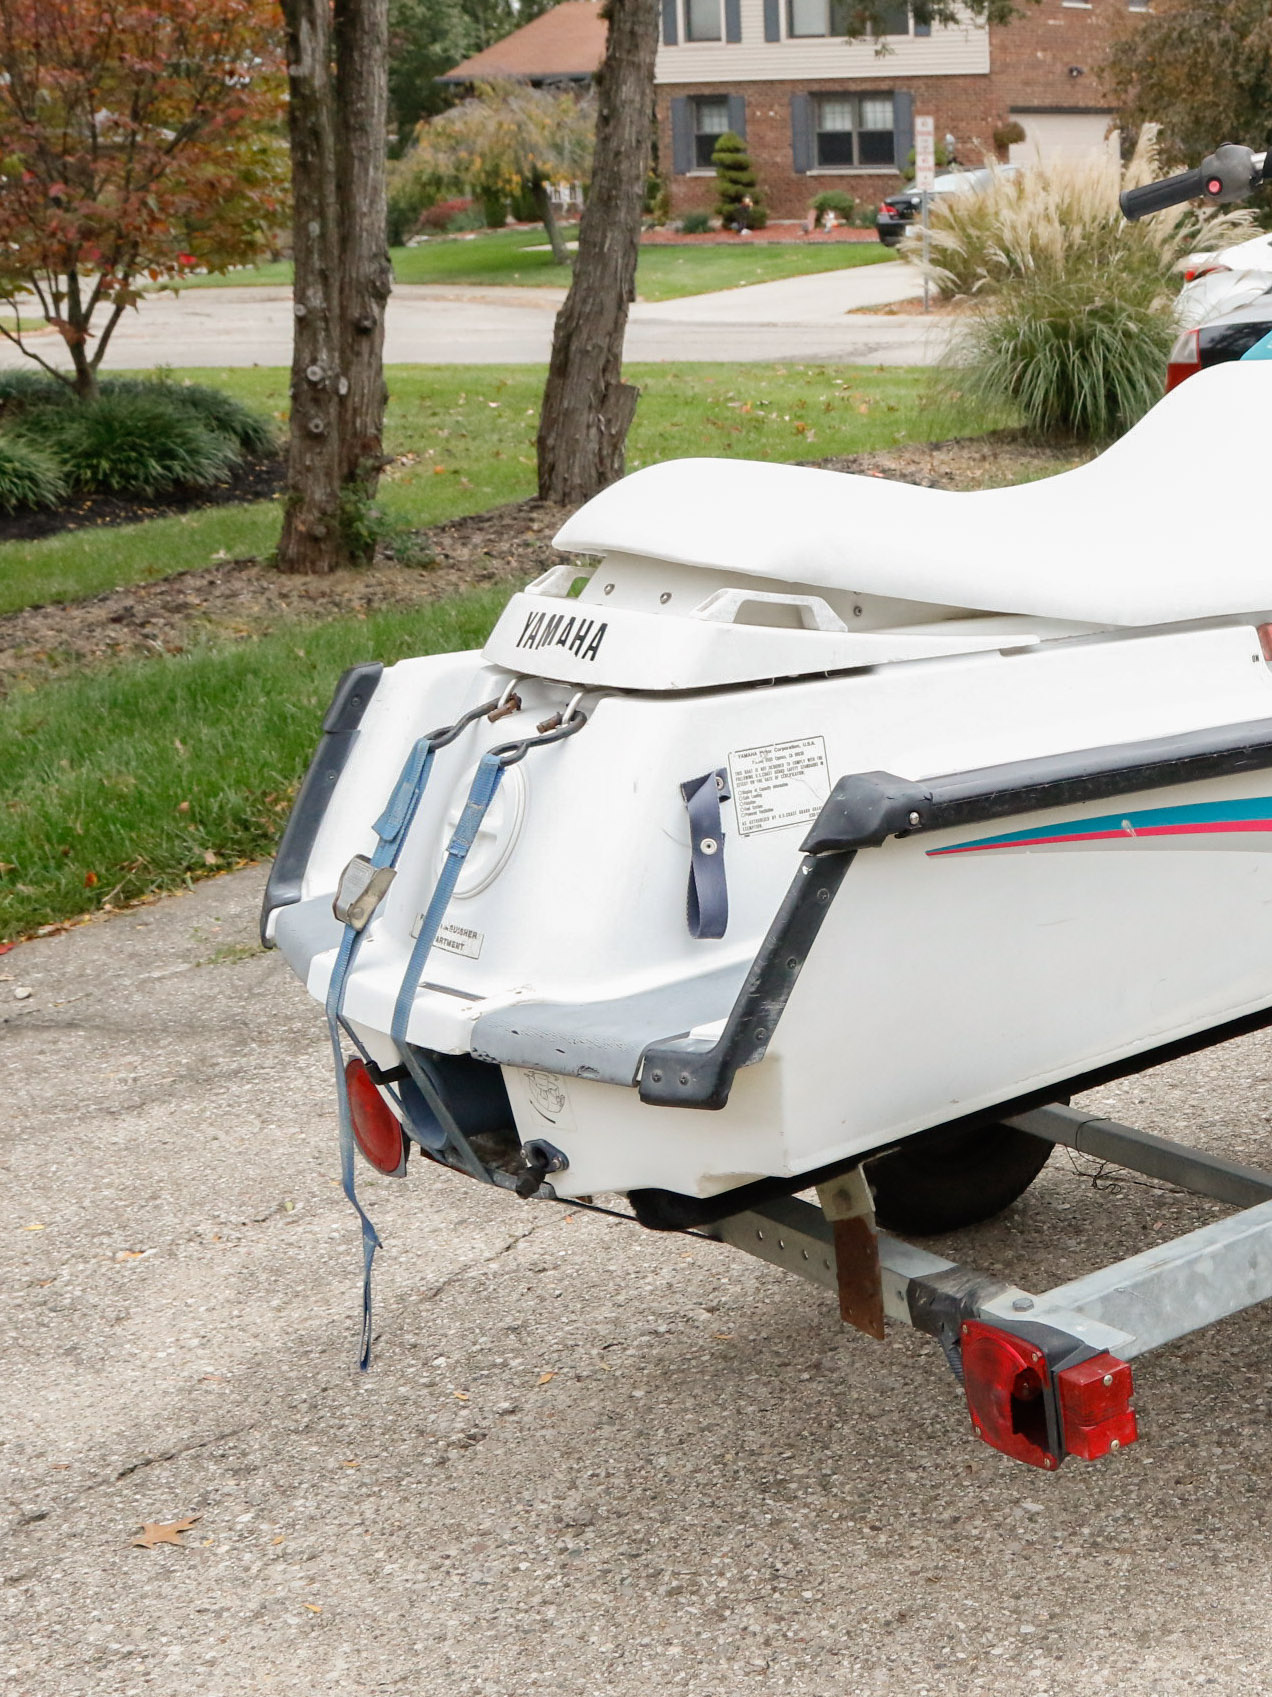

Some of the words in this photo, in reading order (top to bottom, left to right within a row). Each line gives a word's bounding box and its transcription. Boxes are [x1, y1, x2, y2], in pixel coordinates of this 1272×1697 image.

[516, 611, 608, 661] YAMAHA
[440, 924, 478, 940] GUISHER
[435, 936, 465, 951] ARTMENT
